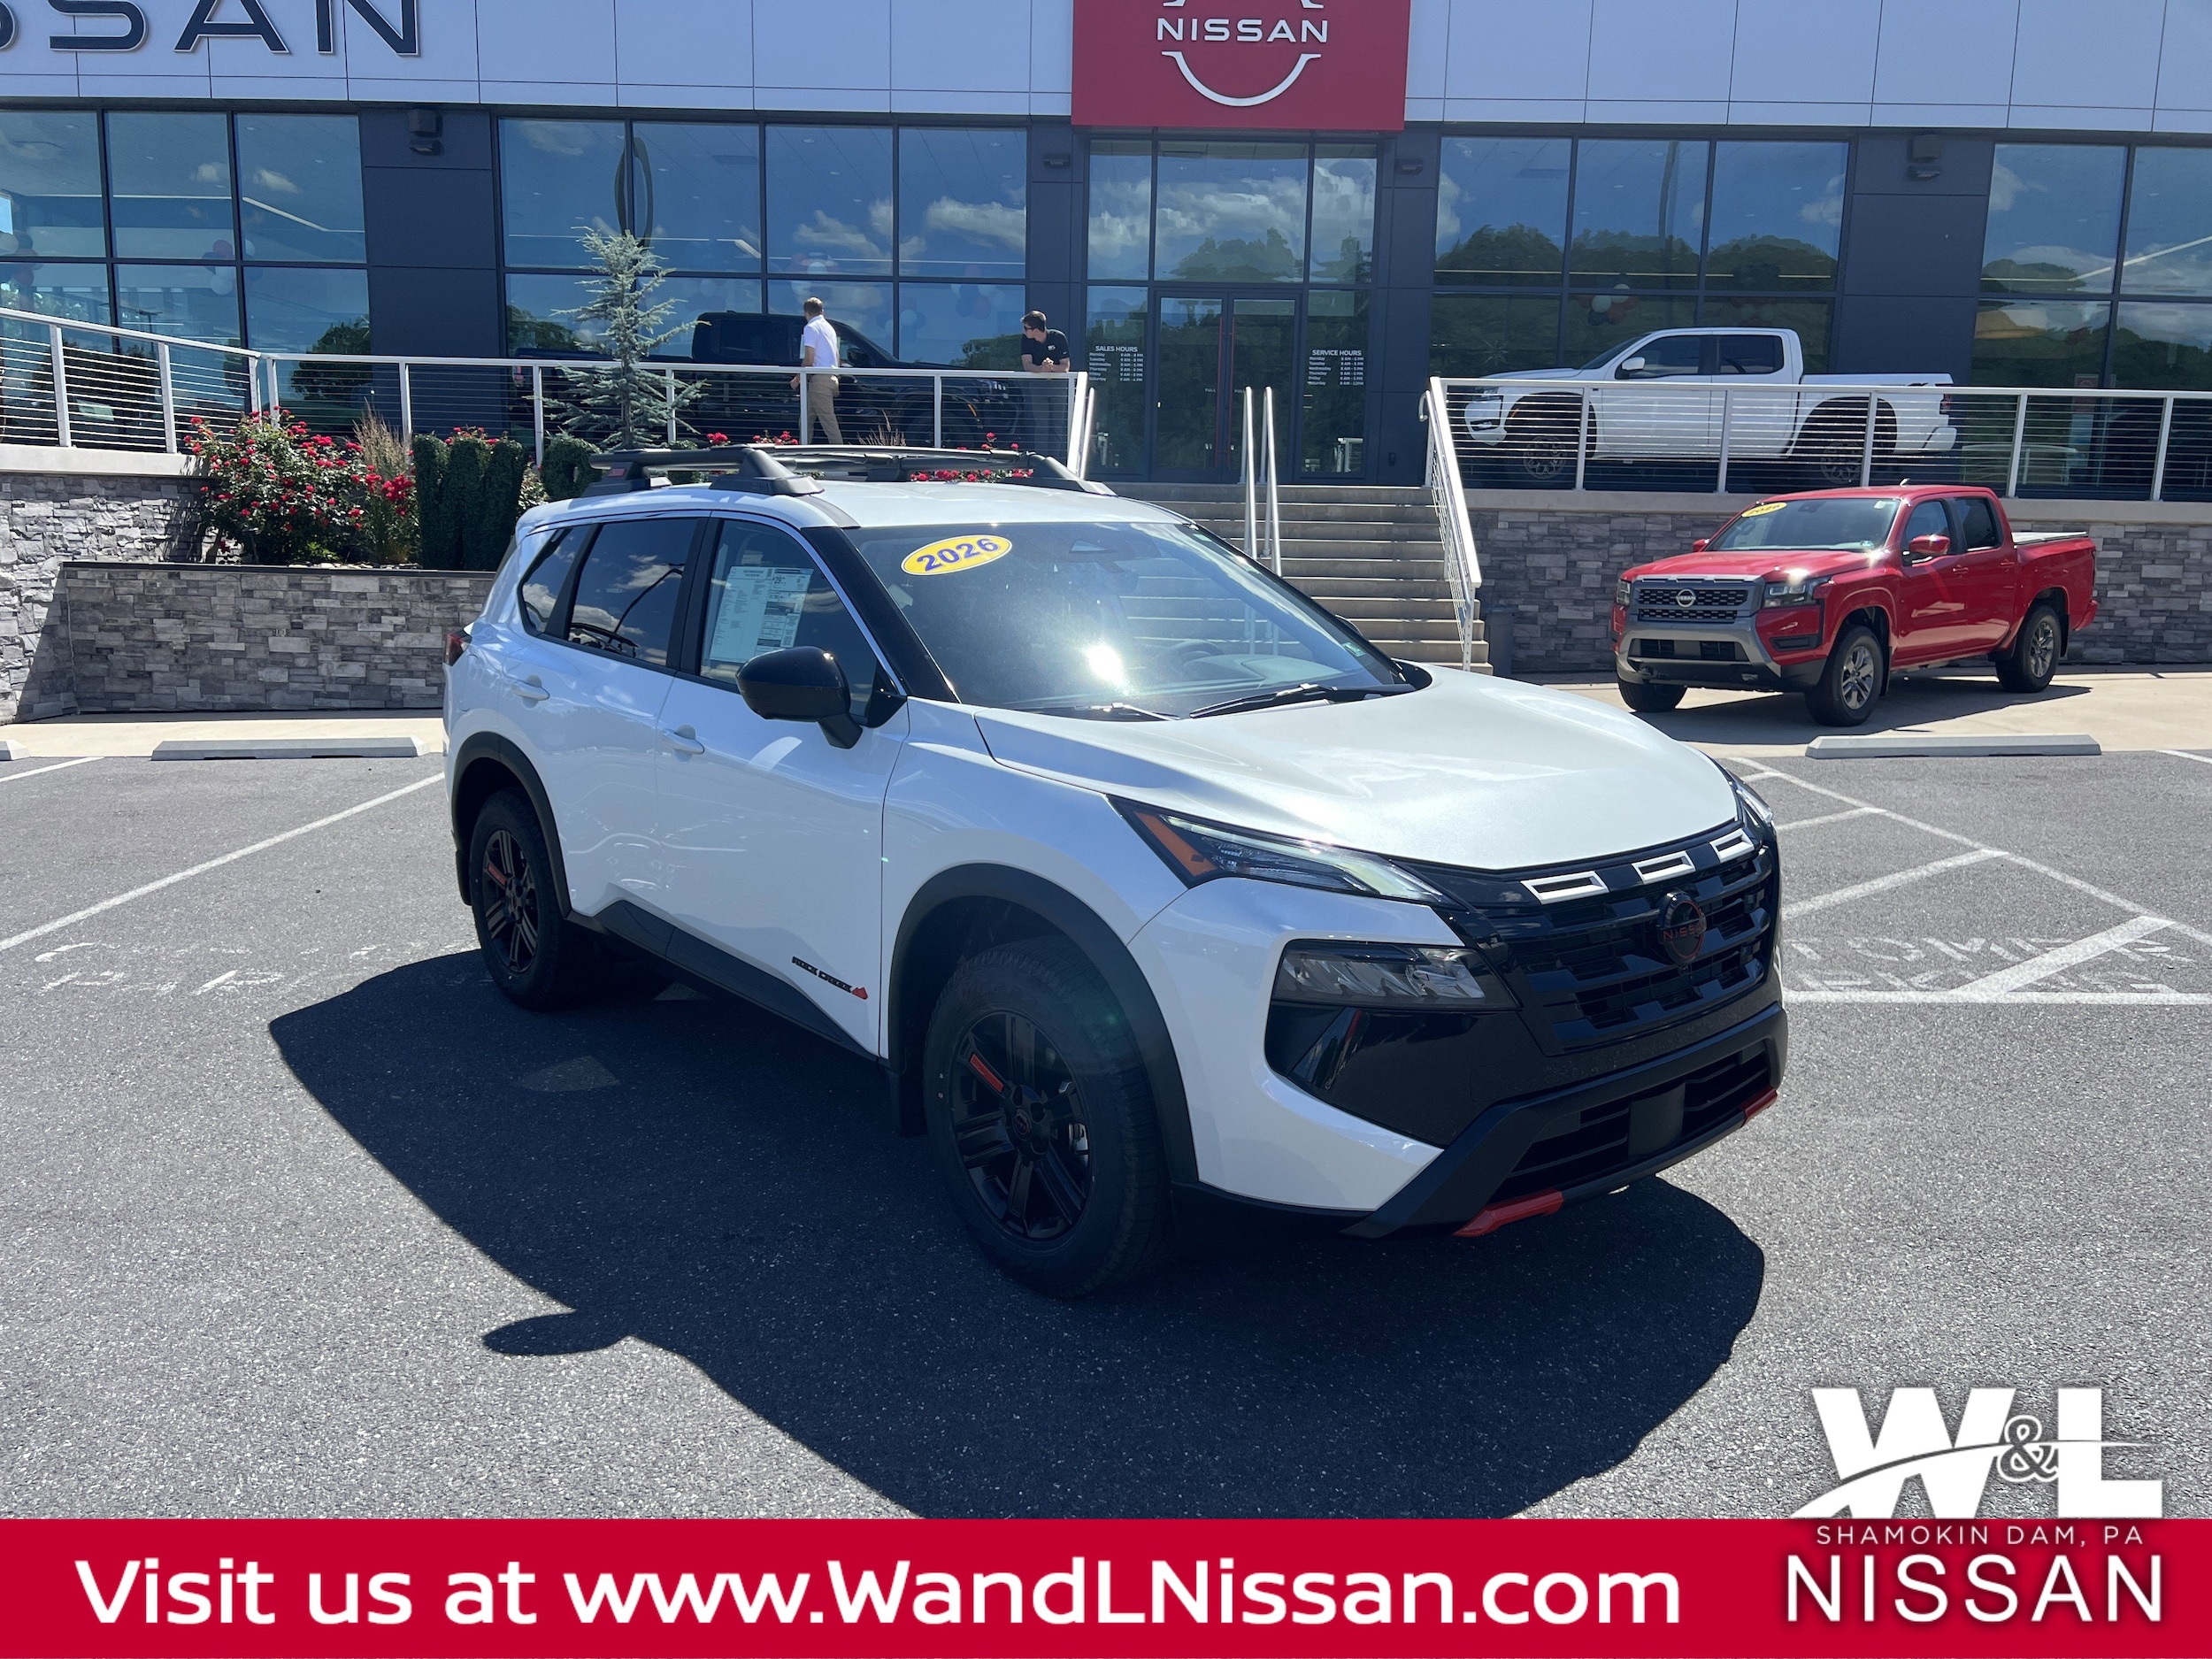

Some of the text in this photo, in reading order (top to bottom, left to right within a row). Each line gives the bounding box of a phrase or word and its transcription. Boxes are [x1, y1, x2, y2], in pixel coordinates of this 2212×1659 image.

[1156, 18, 1328, 43] NISSAN
[917, 538, 999, 572] 2026
[1663, 921, 1704, 941] NISS
[791, 956, 818, 976] ROCK
